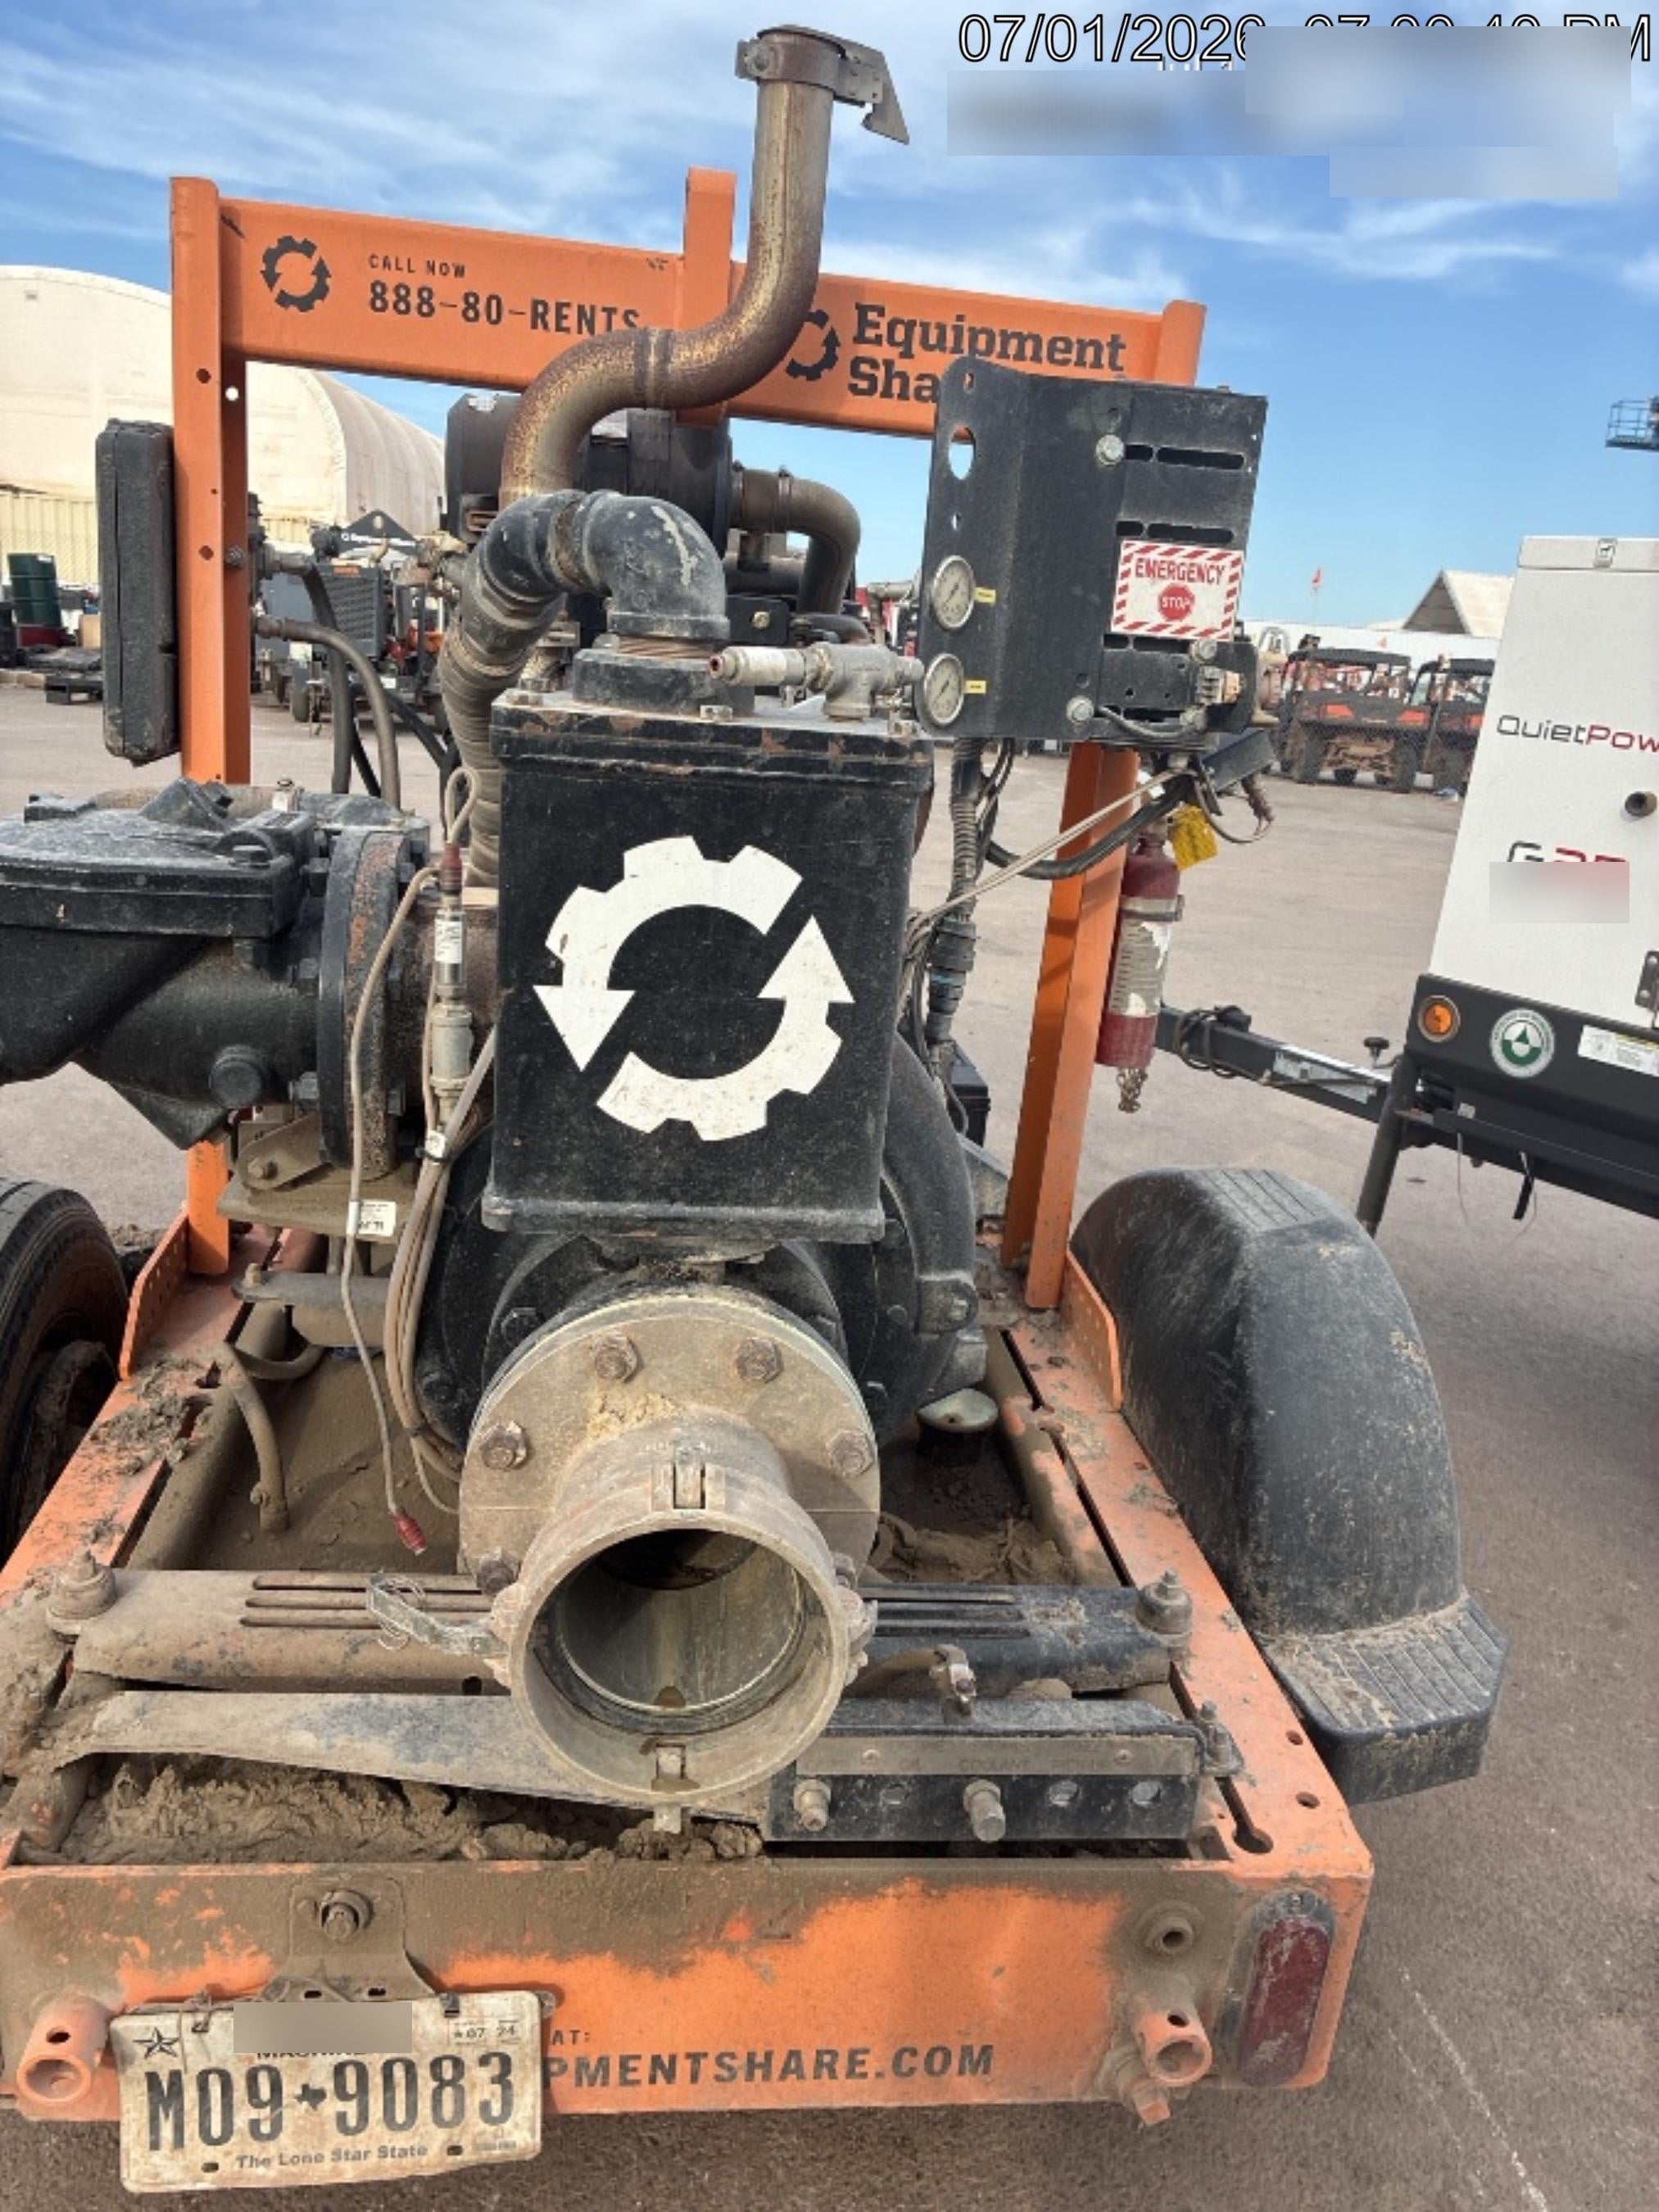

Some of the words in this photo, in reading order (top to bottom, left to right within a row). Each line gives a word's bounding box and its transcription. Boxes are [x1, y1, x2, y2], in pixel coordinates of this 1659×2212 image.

[368, 252, 416, 274] CALL
[425, 259, 466, 279] NOW
[852, 301, 1126, 372] Equipment
[1135, 557, 1226, 586] EMERGENCY
[1162, 596, 1191, 610] STOP
[1496, 714, 1659, 753] QuietPow
[144, 2064, 284, 2151] M09
[333, 2051, 514, 2137] 9083
[235, 2153, 272, 2169] The
[277, 2150, 325, 2166] Lone
[330, 2146, 371, 2163] Star
[377, 2143, 428, 2160] State
